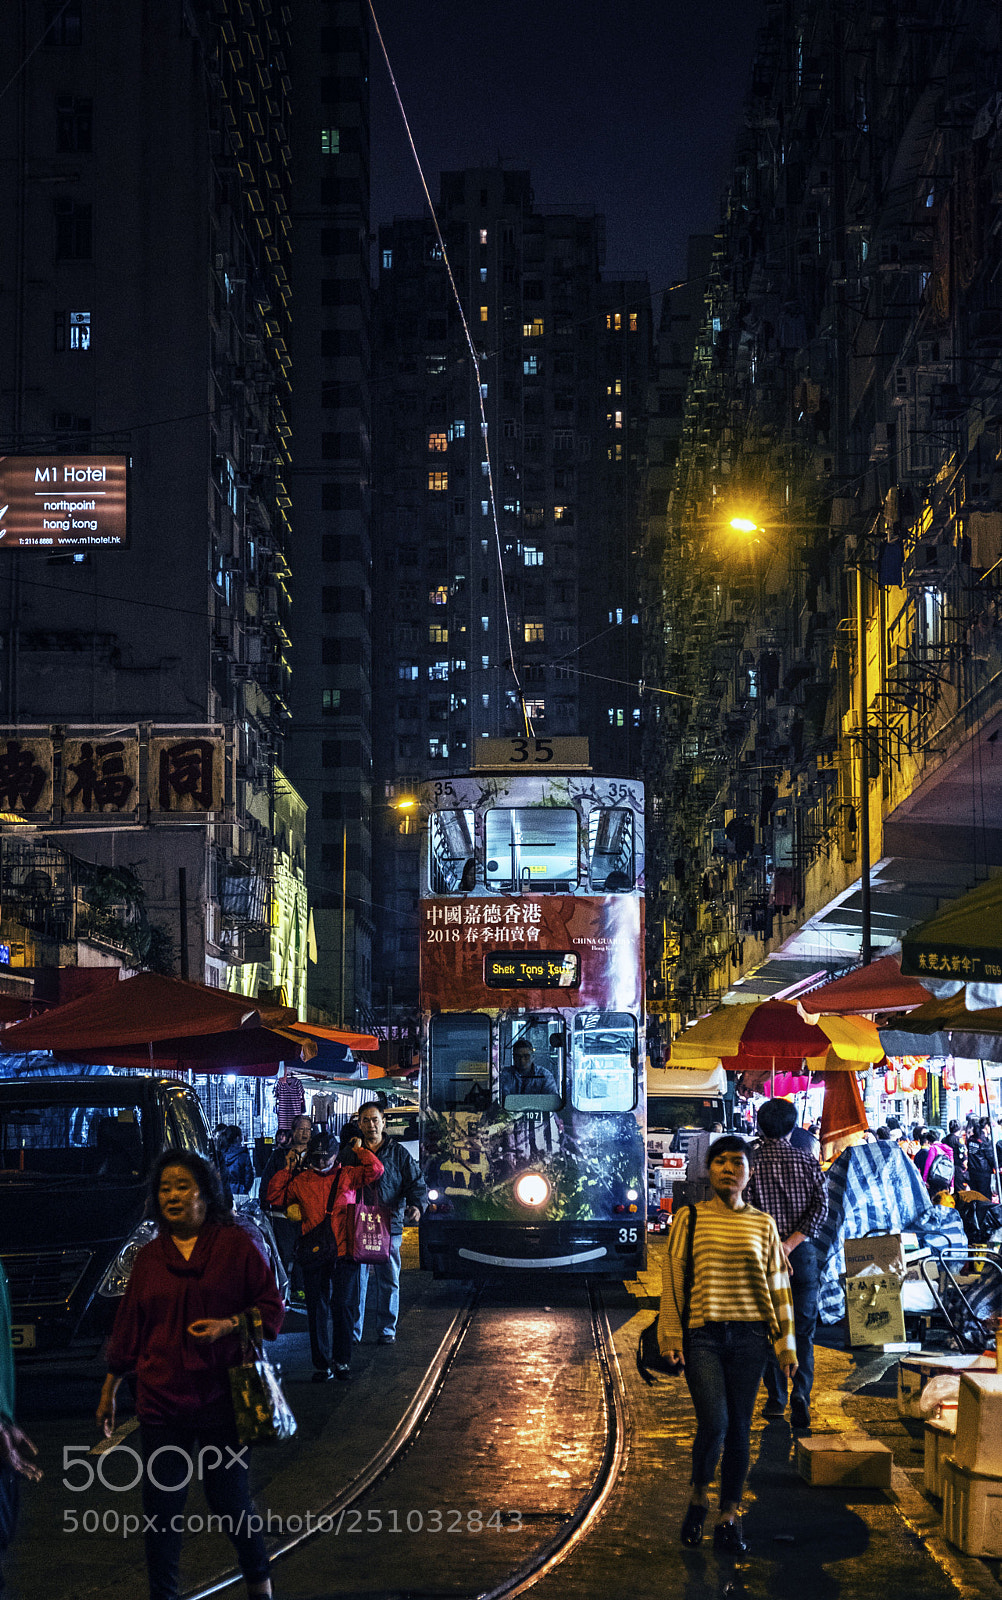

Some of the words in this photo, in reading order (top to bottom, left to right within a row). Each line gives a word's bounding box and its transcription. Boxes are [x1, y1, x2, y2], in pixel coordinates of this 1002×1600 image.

[34, 467, 57, 482] M1
[64, 466, 106, 482] Hotel
[43, 500, 96, 512] northpoint
[43, 519, 70, 531] hong
[71, 519, 98, 531] kong
[58, 536, 121, 545] www.m1hotel.hk
[509, 738, 554, 763] 35
[434, 781, 454, 796] 35
[608, 782, 628, 798] 35
[426, 904, 542, 925] 中國嘉德香港
[427, 928, 460, 943] 2018
[464, 926, 541, 943] 春季拍賣會
[572, 937, 596, 945] CHINA
[492, 963, 515, 975] Shek
[520, 963, 544, 976] Tong
[918, 952, 981, 973] 东莞大新伞厂
[618, 1227, 638, 1243] 35
